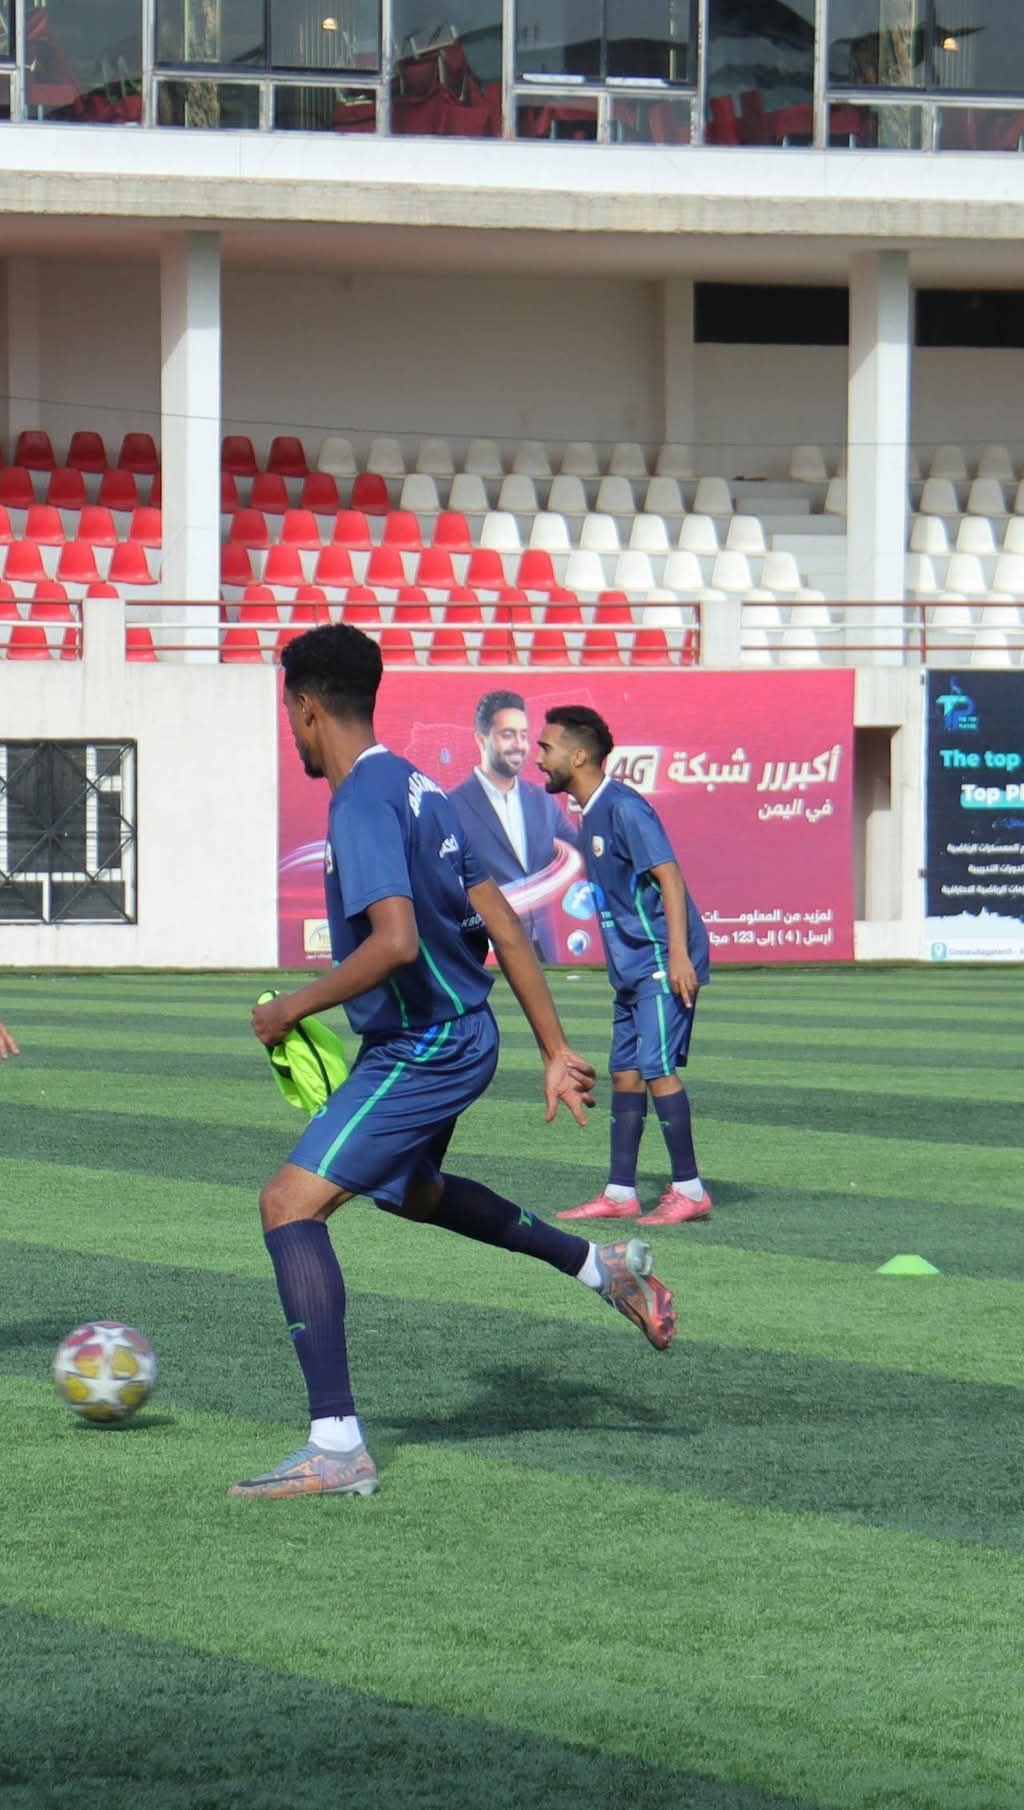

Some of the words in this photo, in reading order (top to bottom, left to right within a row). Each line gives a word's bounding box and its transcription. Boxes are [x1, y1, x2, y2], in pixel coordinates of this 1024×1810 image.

[667, 747, 752, 792] شبكة
[756, 744, 842, 792] أكبررر
[940, 749, 980, 768] The
[984, 750, 1021, 772] top
[961, 783, 1000, 805] Top
[757, 798, 804, 821] اليمن
[805, 799, 833, 823] في
[783, 910, 801, 924] من
[803, 909, 833, 924] لمزيد
[732, 930, 755, 944] 123
[756, 930, 775, 945] إلى
[803, 928, 832, 945] أرسل
